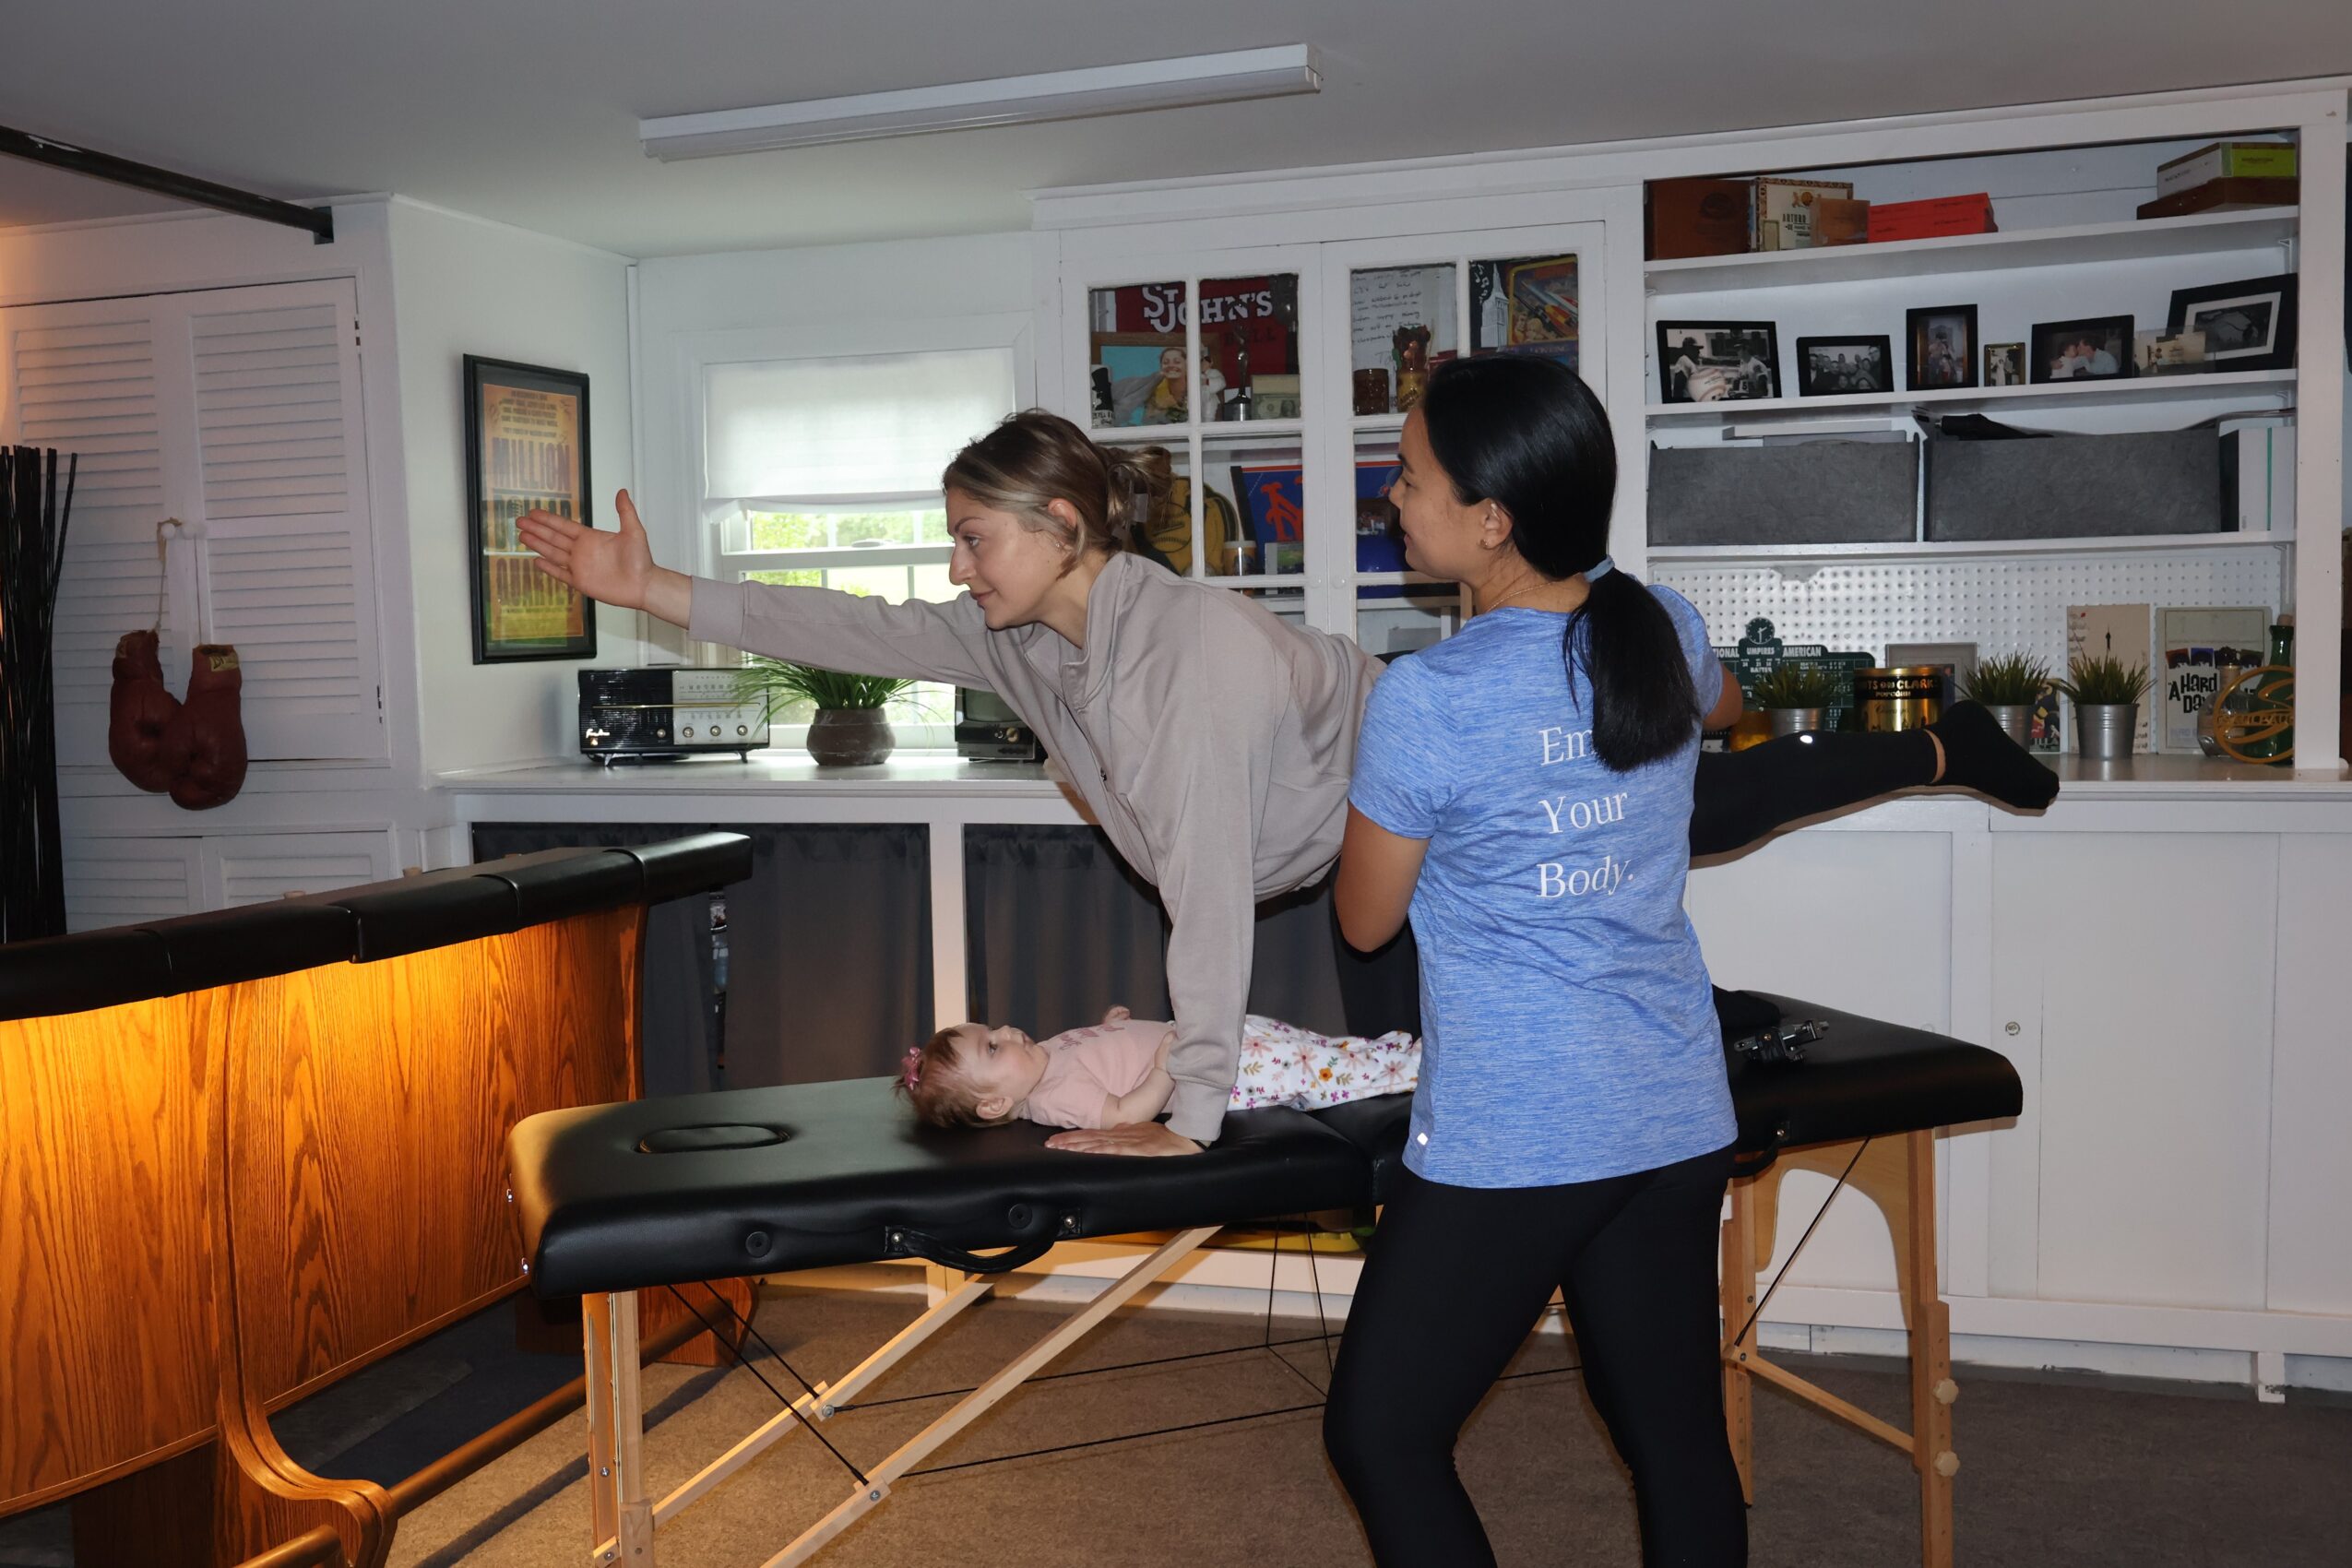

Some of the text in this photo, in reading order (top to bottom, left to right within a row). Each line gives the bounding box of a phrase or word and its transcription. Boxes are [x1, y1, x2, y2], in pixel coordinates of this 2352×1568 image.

[492, 436, 571, 491] MILLION
[1747, 647, 1775, 656] UMPIRES
[1783, 647, 1822, 658] AMERICAN
[1896, 678, 1934, 690] CLARK
[1538, 792, 1628, 834] Your
[1536, 855, 1634, 898] Body.
